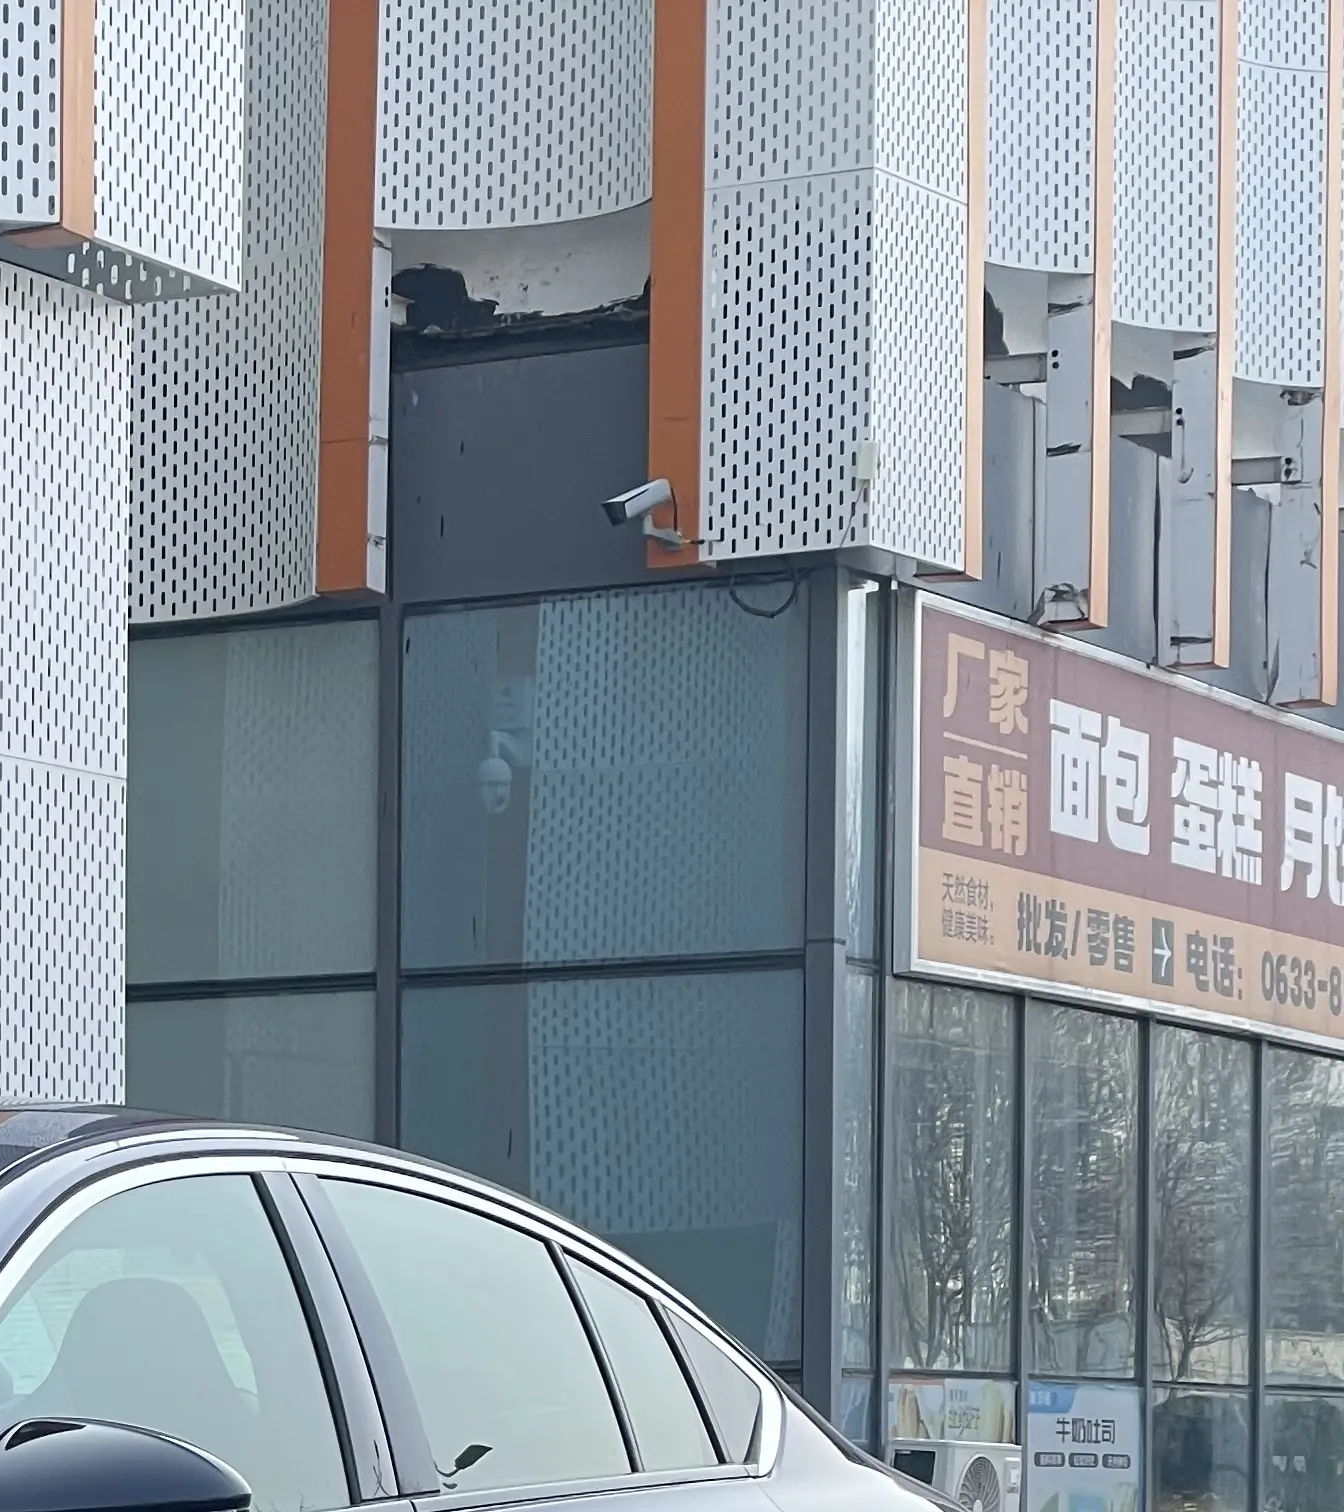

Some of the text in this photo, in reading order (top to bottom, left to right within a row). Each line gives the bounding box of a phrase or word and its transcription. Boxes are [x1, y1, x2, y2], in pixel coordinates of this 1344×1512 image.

[943, 633, 1028, 734] 厂家
[943, 755, 1027, 856] 直销
[1050, 698, 1150, 856] 面包
[1171, 736, 1262, 886] 蛋糕
[1017, 892, 1136, 973] 批发/零售
[1055, 1417, 1116, 1444] 牛奶吐司
